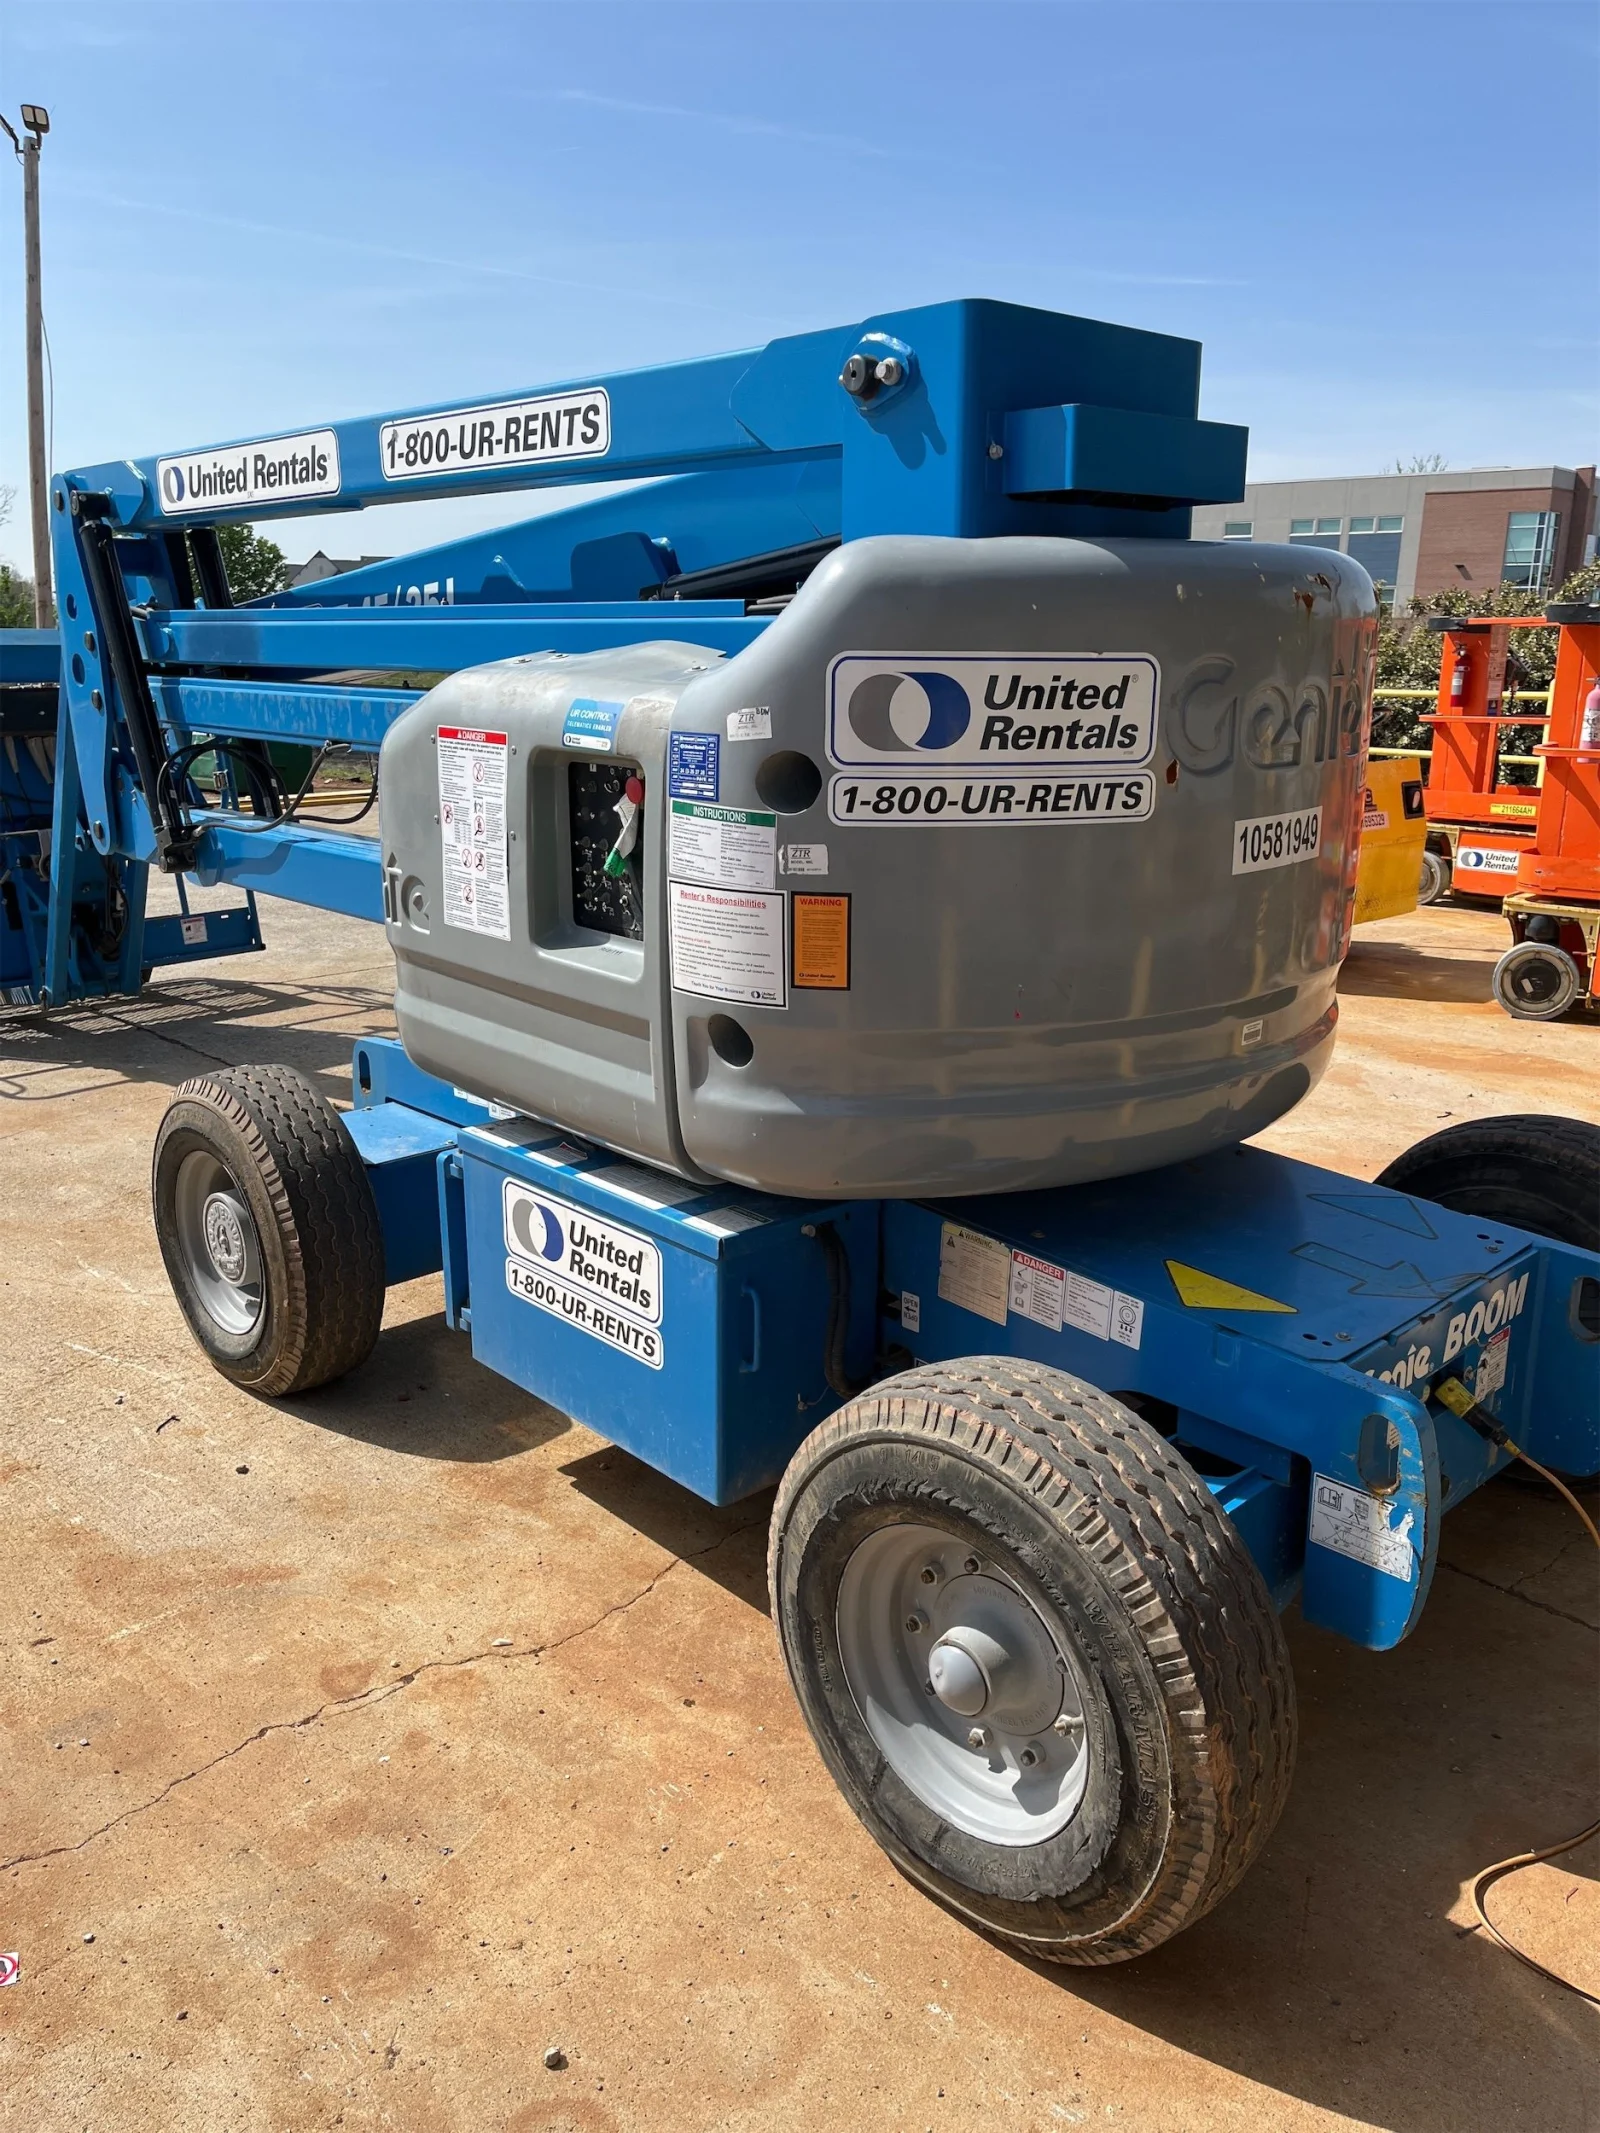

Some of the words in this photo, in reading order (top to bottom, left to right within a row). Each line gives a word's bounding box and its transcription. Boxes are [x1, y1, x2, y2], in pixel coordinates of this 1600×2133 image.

[387, 404, 600, 469] 1-800-UR-RENTS
[188, 457, 248, 499] United
[253, 445, 328, 490] Rentals
[983, 674, 1131, 710] United
[738, 713, 755, 723] ZTR
[979, 714, 1140, 751] Rentals
[1167, 654, 1362, 778] Genie
[462, 731, 486, 742] DANGER
[693, 806, 747, 823] INSTRUCTIONS
[842, 781, 1144, 815] 1-800-UR-RENTS
[791, 849, 811, 858] ZTR
[1239, 813, 1319, 864] 10581949
[1483, 861, 1518, 872] Rentals
[1485, 853, 1517, 863] United
[680, 890, 706, 902] Renter's
[706, 894, 767, 909] Responsibilities
[800, 898, 842, 907] WARNING
[569, 1220, 644, 1276] United
[569, 1248, 651, 1309] Rentals
[1023, 1255, 1061, 1279] DANGER
[511, 1268, 656, 1358] 1-800-UR-RENTS
[903, 1296, 918, 1308] OPEN
[1443, 1272, 1530, 1363] BOOM
